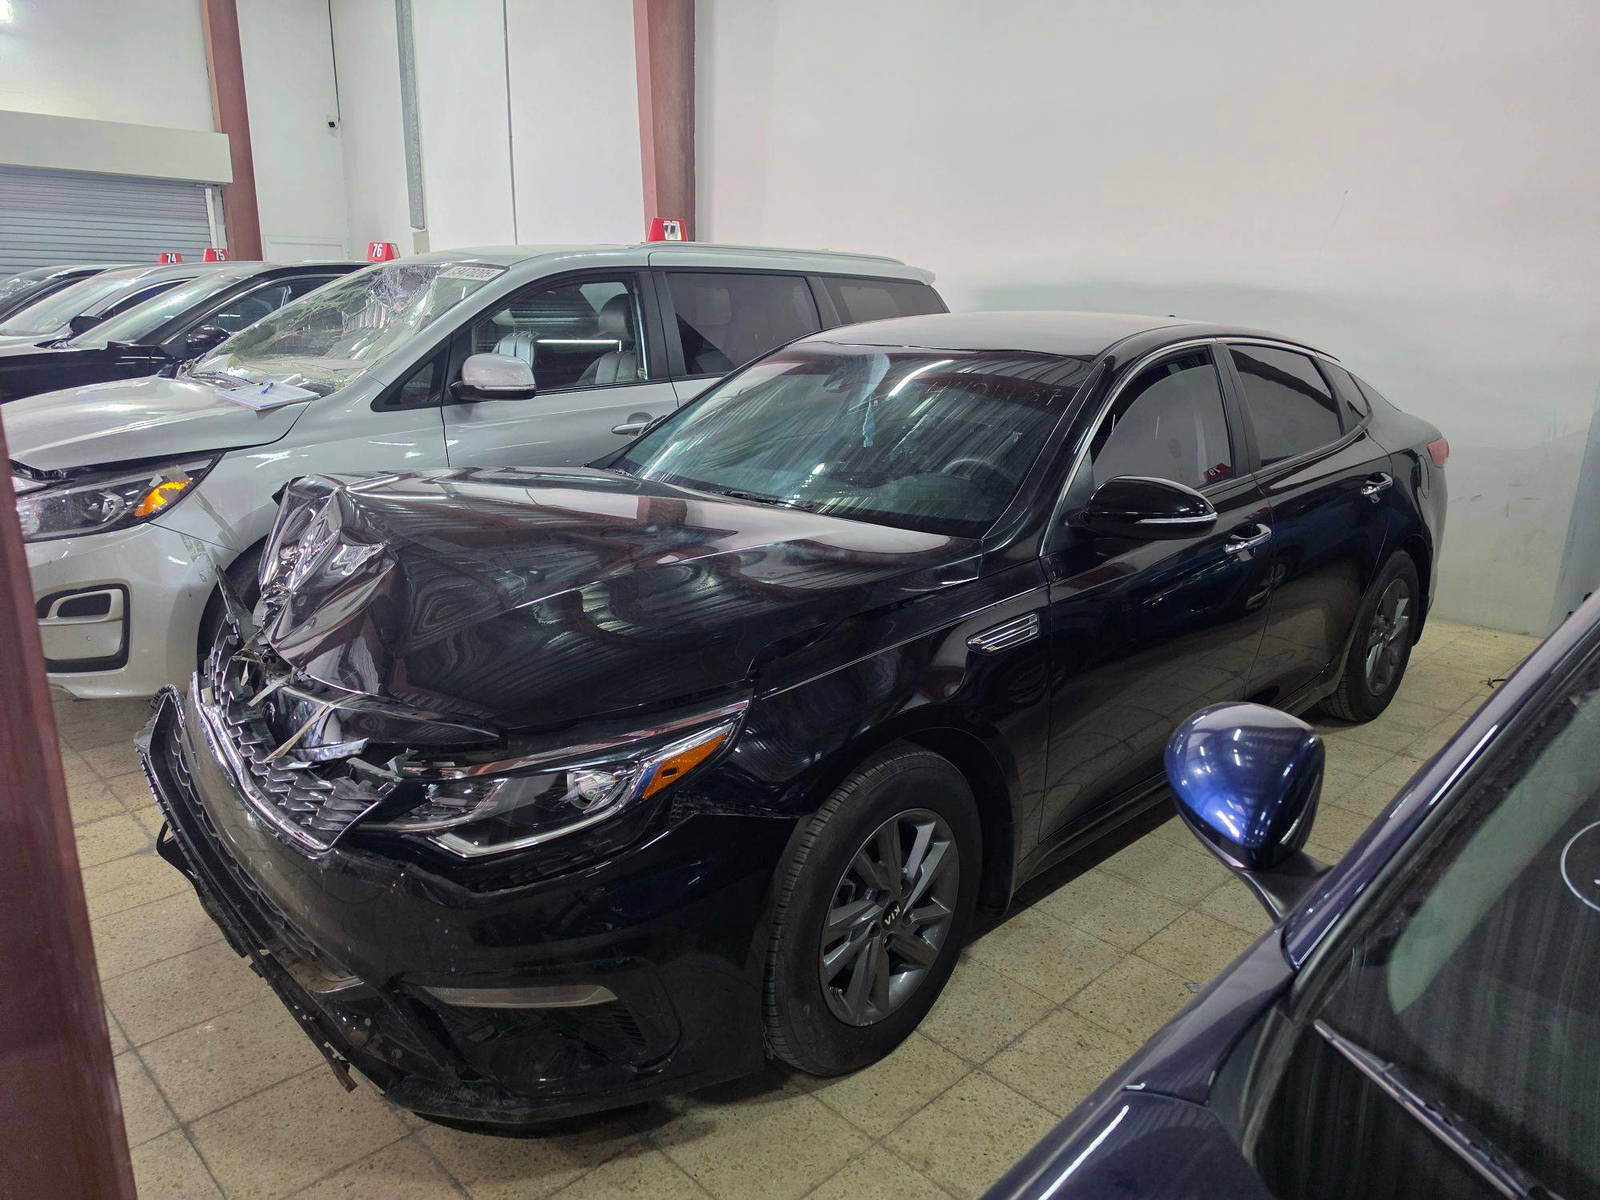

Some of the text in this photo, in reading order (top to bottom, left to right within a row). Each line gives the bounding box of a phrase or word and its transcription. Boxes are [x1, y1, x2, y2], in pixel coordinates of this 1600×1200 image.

[213, 249, 226, 262] 75
[372, 243, 383, 258] 76
[165, 253, 177, 264] 74
[884, 904, 901, 926] KIA
